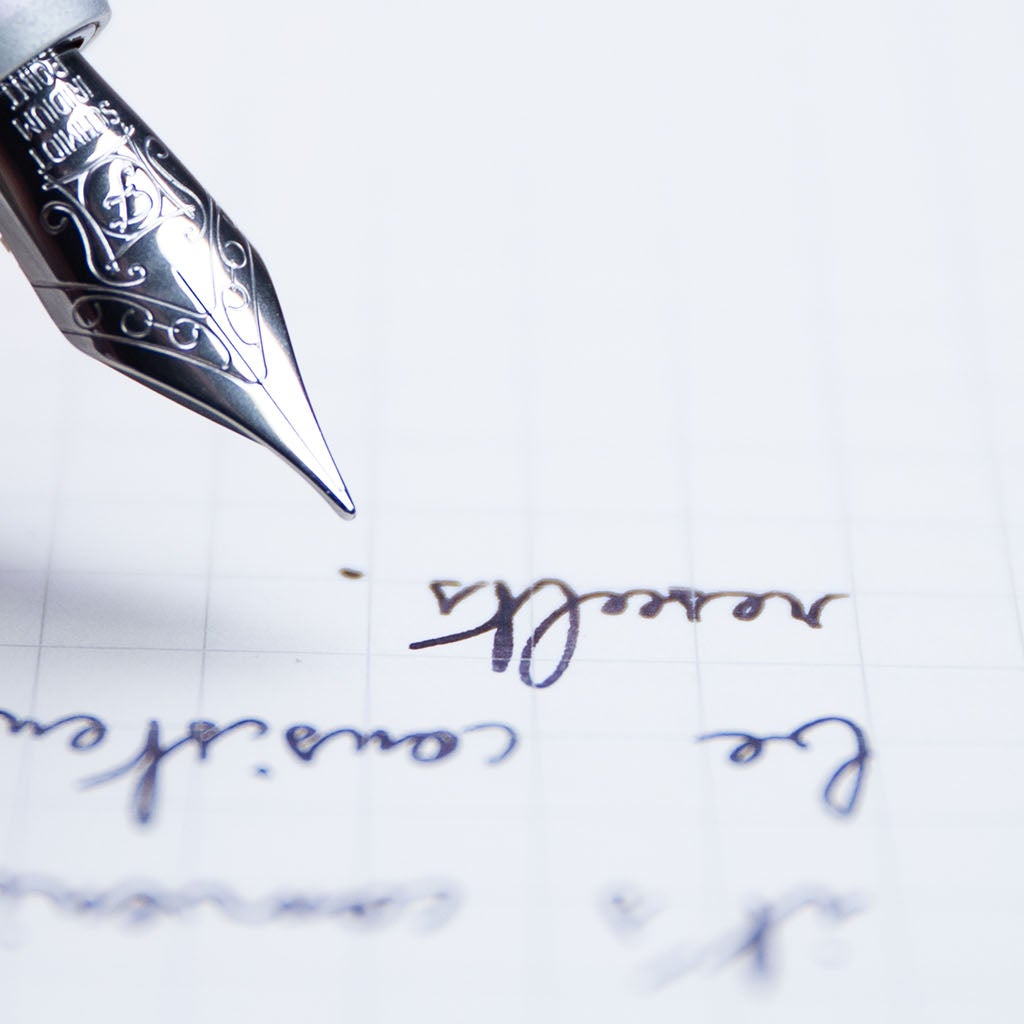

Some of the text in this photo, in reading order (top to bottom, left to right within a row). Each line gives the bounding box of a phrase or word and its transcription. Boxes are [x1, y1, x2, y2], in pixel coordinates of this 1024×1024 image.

[0, 50, 70, 111] POINT
[10, 74, 95, 142] IRIDIUM
[28, 99, 122, 175] SCHMIDT
[693, 716, 871, 818] be
